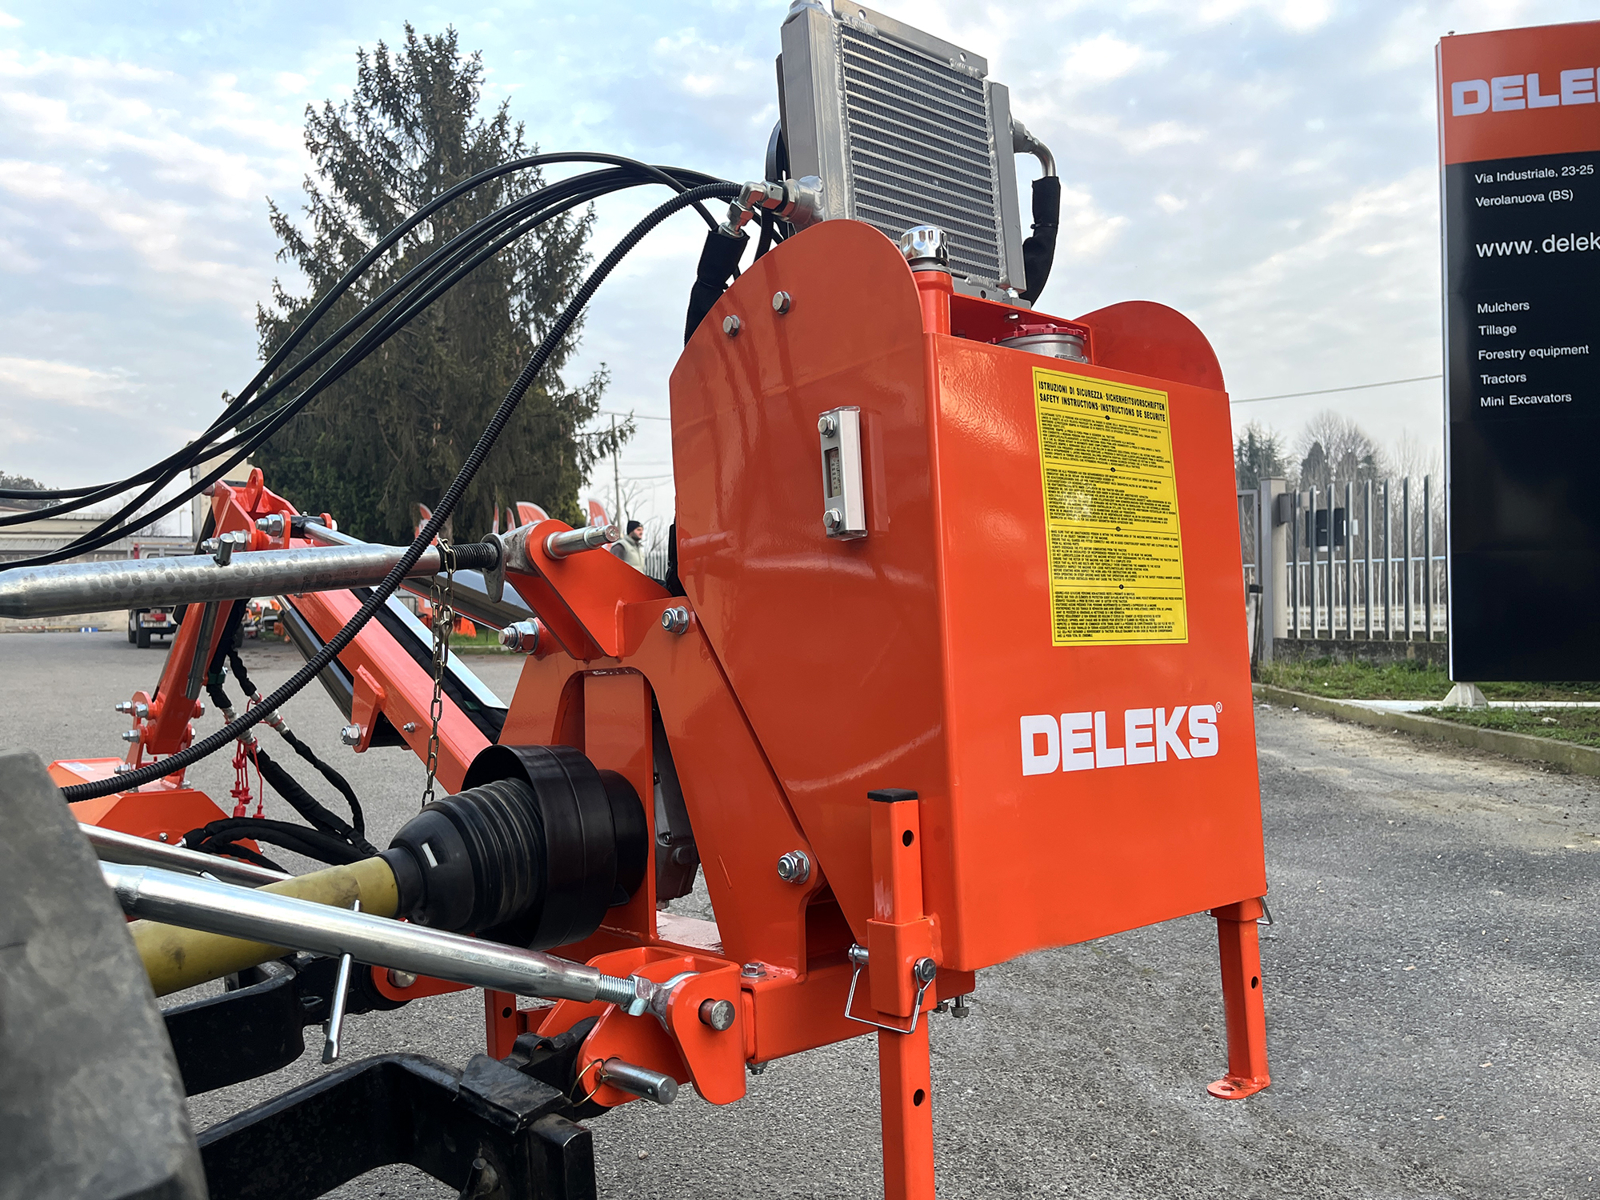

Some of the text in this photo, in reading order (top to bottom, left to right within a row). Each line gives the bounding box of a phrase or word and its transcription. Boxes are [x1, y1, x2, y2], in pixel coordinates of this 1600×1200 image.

[1451, 67, 1600, 117] DELE
[1475, 173, 1493, 184] Via
[1561, 165, 1594, 177] 23-25
[1476, 189, 1574, 207] Verolanuova (BS)
[1477, 301, 1530, 314] Mulchers
[1478, 324, 1517, 337] Tillage
[1478, 344, 1590, 361] Forestry equipment
[1480, 373, 1527, 385] Tractors
[1038, 380, 1068, 394] ISTRUZIONI
[1069, 386, 1075, 395] DI
[1039, 392, 1060, 405] SAFETY
[1136, 409, 1142, 418] DE
[1480, 393, 1572, 407] Mini Excavators
